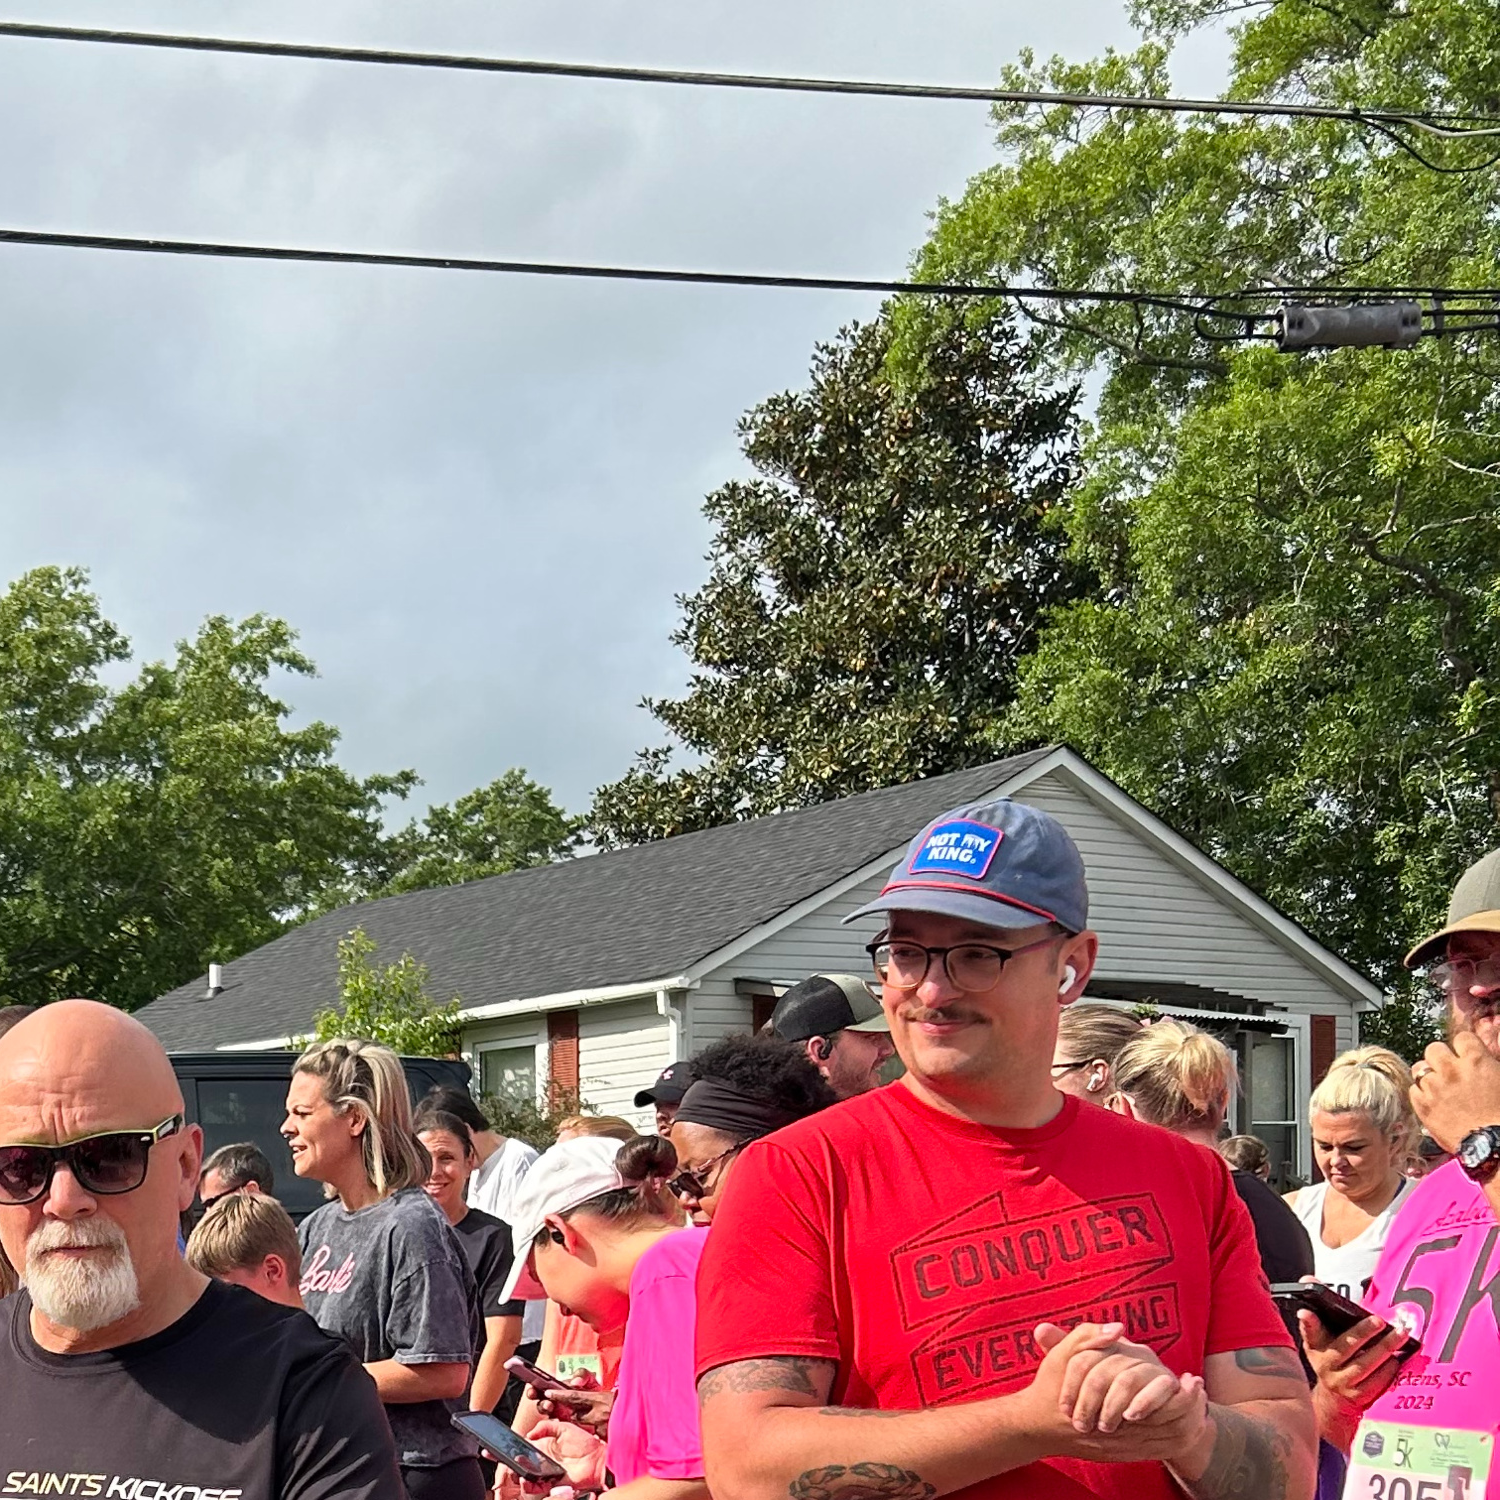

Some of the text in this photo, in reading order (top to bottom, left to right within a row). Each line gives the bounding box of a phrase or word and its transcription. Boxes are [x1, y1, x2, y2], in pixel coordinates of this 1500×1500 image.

[926, 833, 960, 848] NOT
[914, 1206, 1155, 1299] CONQUER
[1447, 1371, 1473, 1388] SC
[2, 1471, 106, 1497] SAINTS
